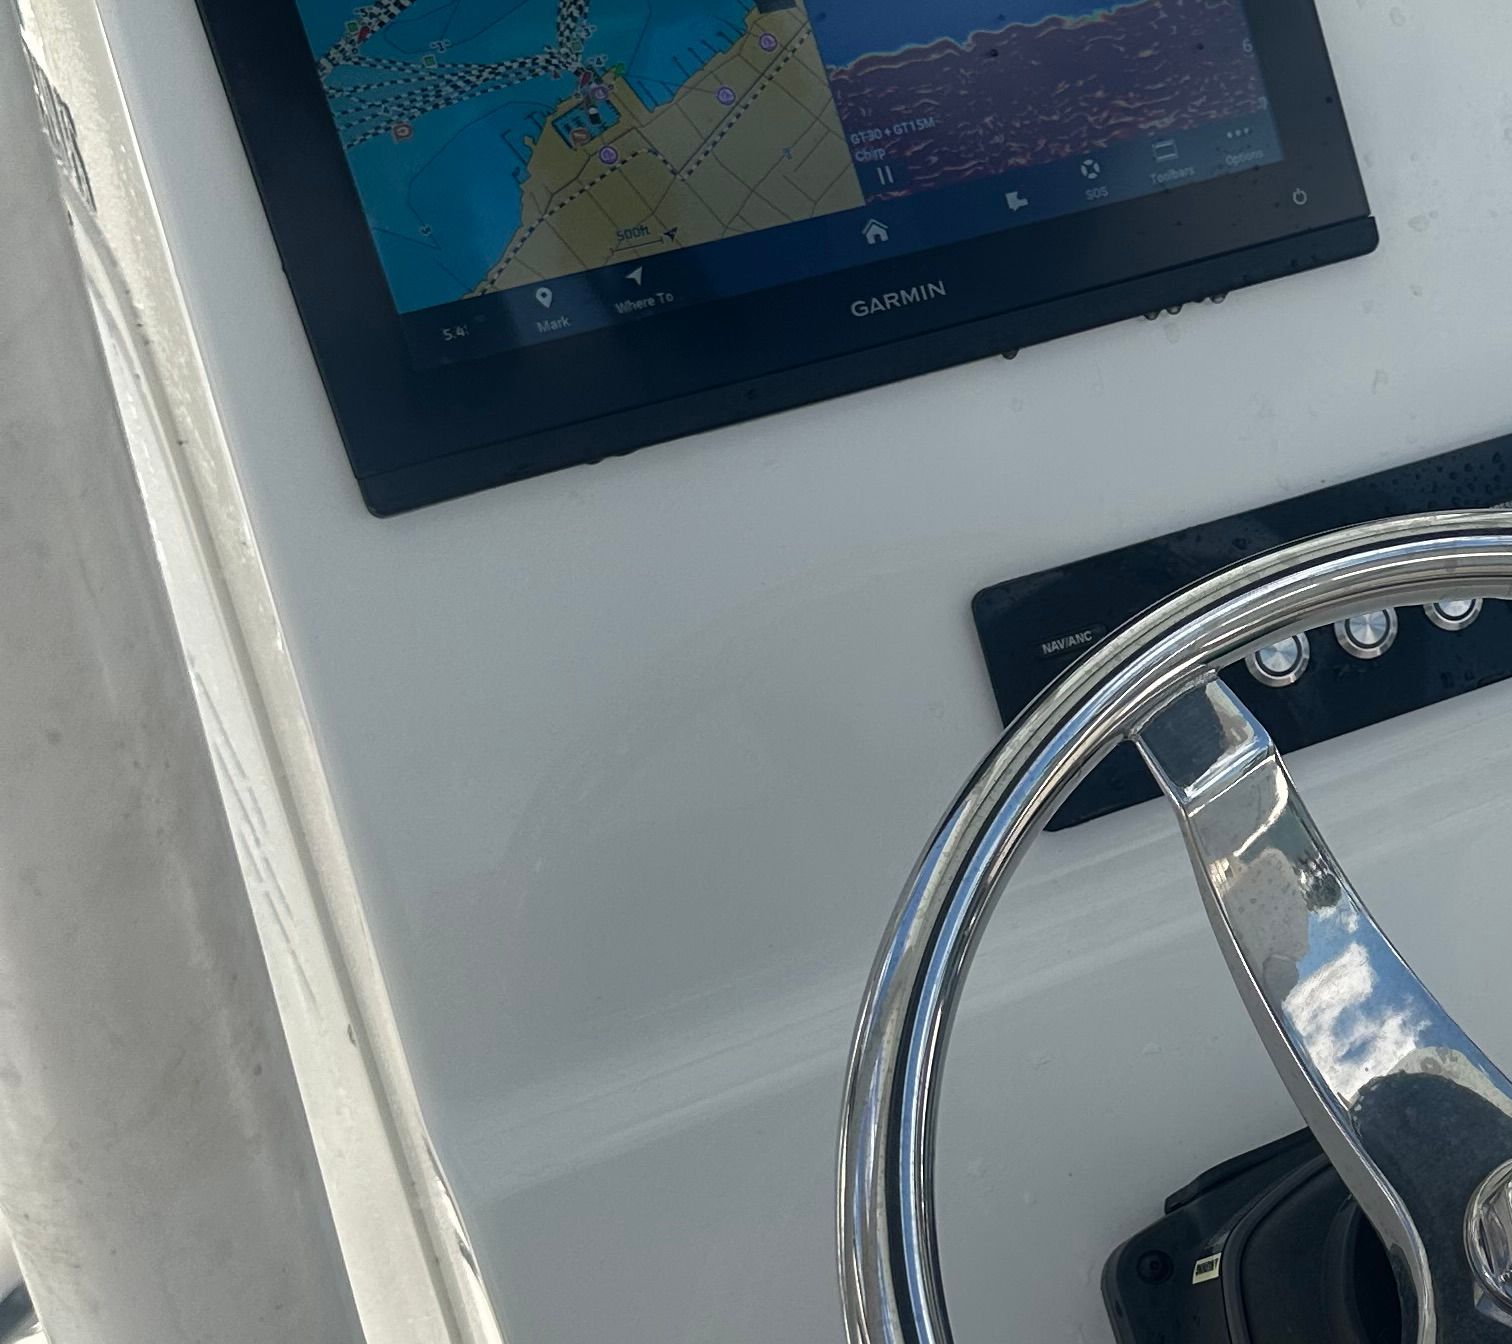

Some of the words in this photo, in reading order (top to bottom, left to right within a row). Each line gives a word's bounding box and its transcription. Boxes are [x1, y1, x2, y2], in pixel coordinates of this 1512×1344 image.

[1225, 147, 1264, 168] Options
[1149, 165, 1196, 185] Toolbars
[1085, 186, 1109, 202] SOS
[615, 296, 656, 316] Where
[656, 290, 675, 305] To
[849, 280, 948, 318] GARMIN
[535, 316, 571, 335] Mark
[1042, 630, 1093, 655] NAV/ANC
